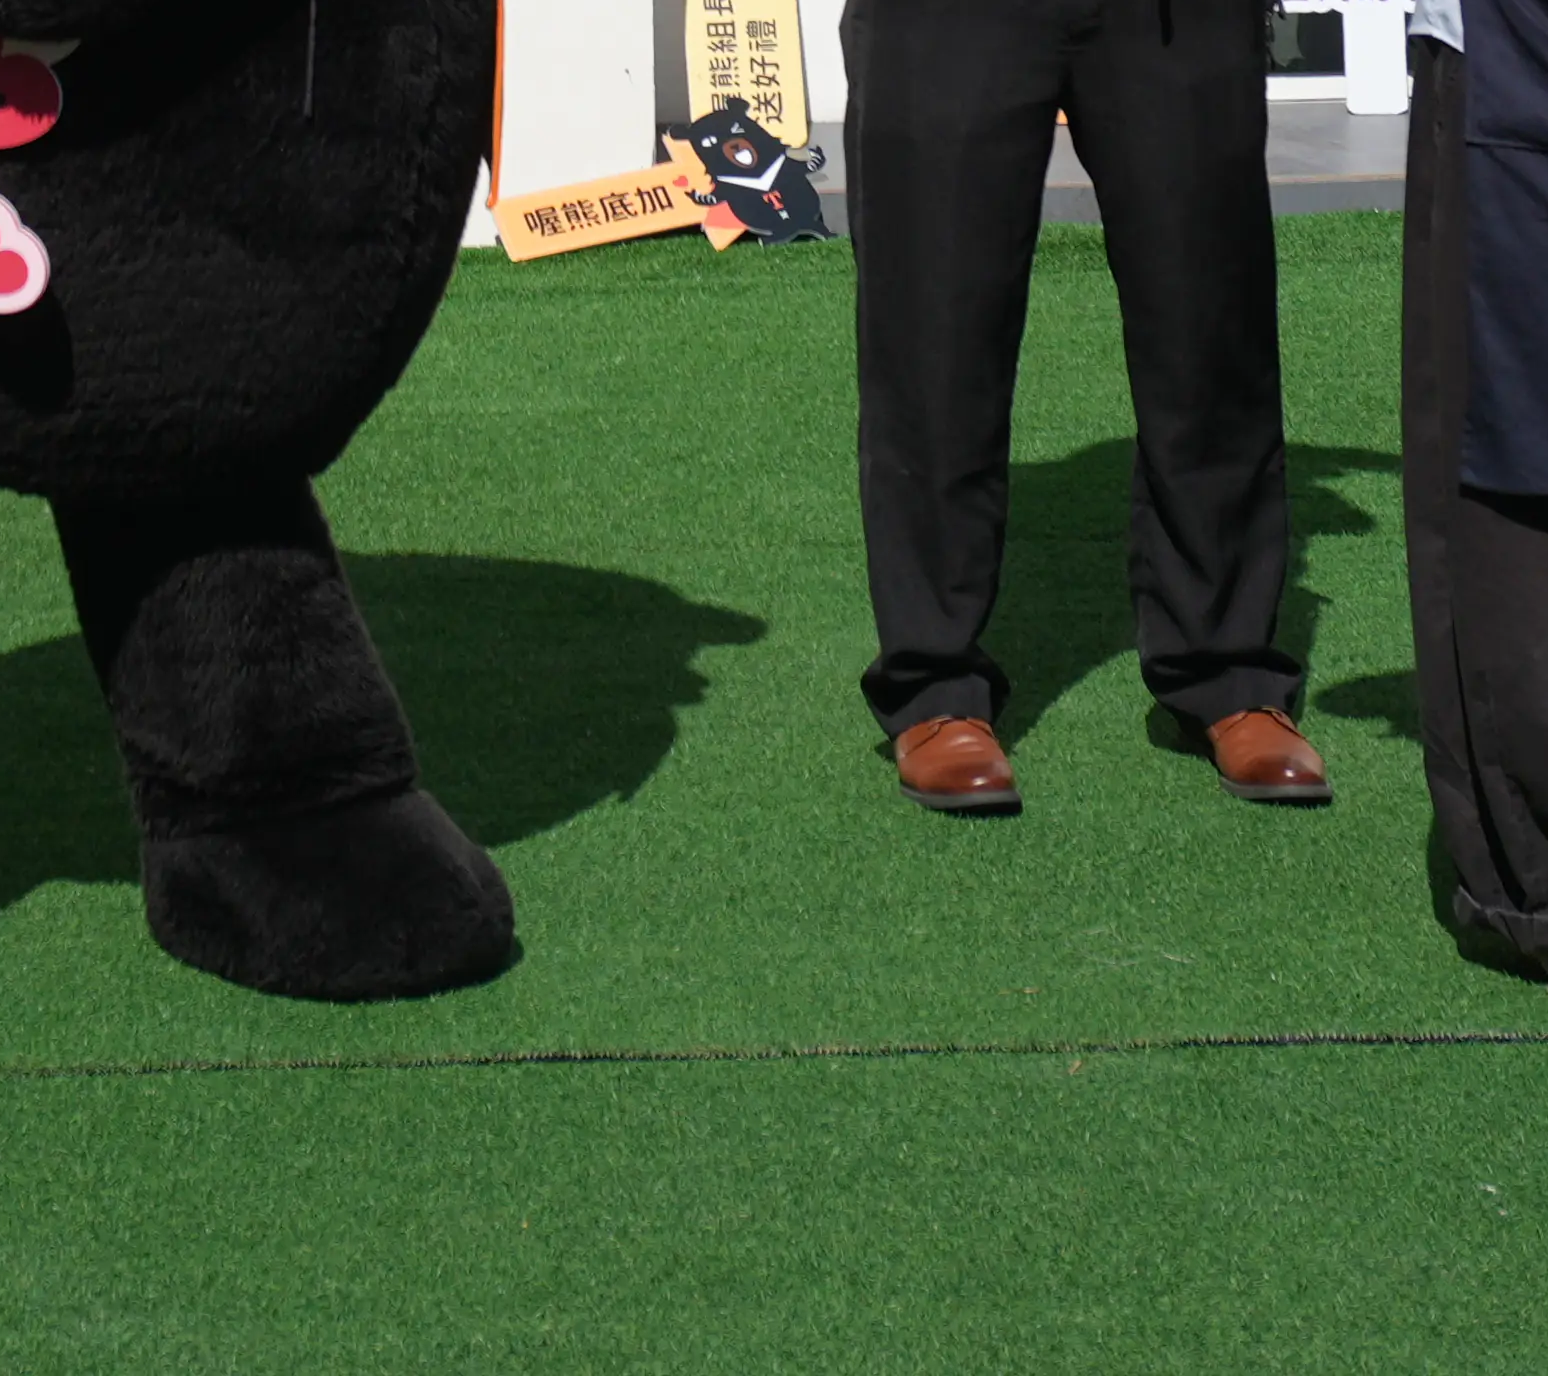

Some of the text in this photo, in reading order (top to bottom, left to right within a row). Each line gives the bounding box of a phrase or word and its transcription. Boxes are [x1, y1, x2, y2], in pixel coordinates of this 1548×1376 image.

[745, 18, 785, 124] 送好禮
[524, 185, 675, 238] 喔熊底加
